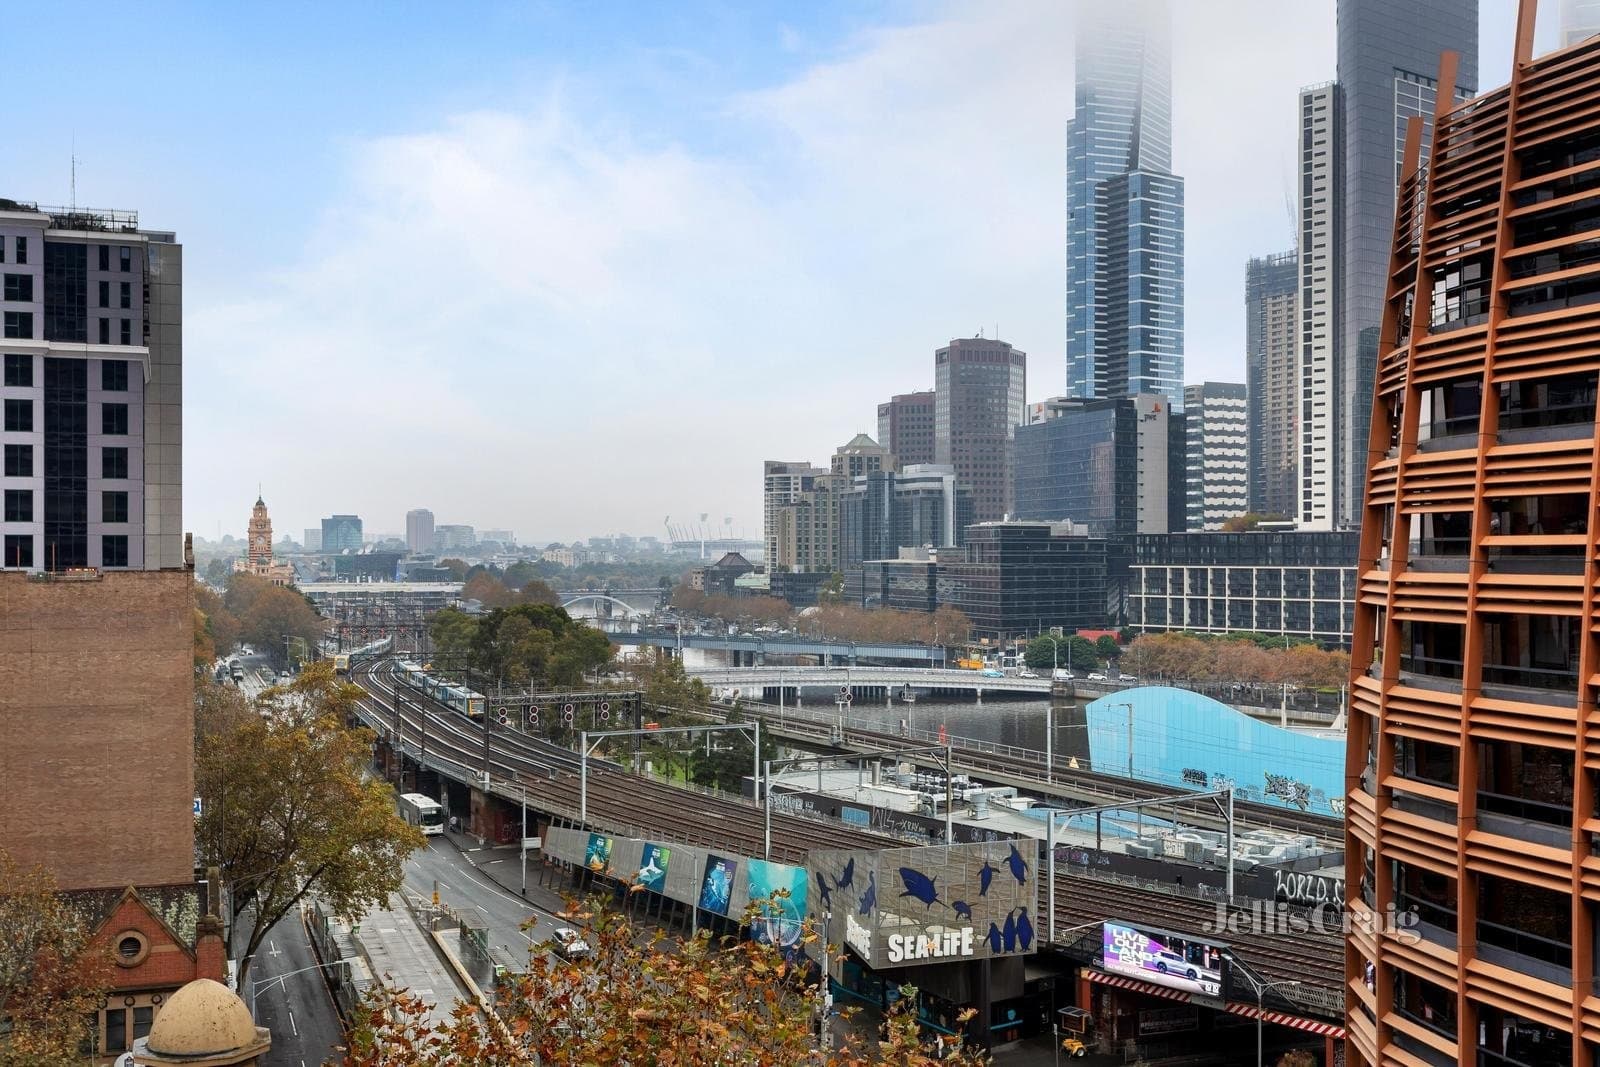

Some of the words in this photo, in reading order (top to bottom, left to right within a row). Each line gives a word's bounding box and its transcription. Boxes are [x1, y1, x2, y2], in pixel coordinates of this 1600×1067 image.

[1113, 929, 1150, 944] LIVE
[888, 934, 929, 963] SEA
[1115, 938, 1149, 951] OUT
[1109, 944, 1153, 961] LAND
[1119, 954, 1144, 967] ISH
